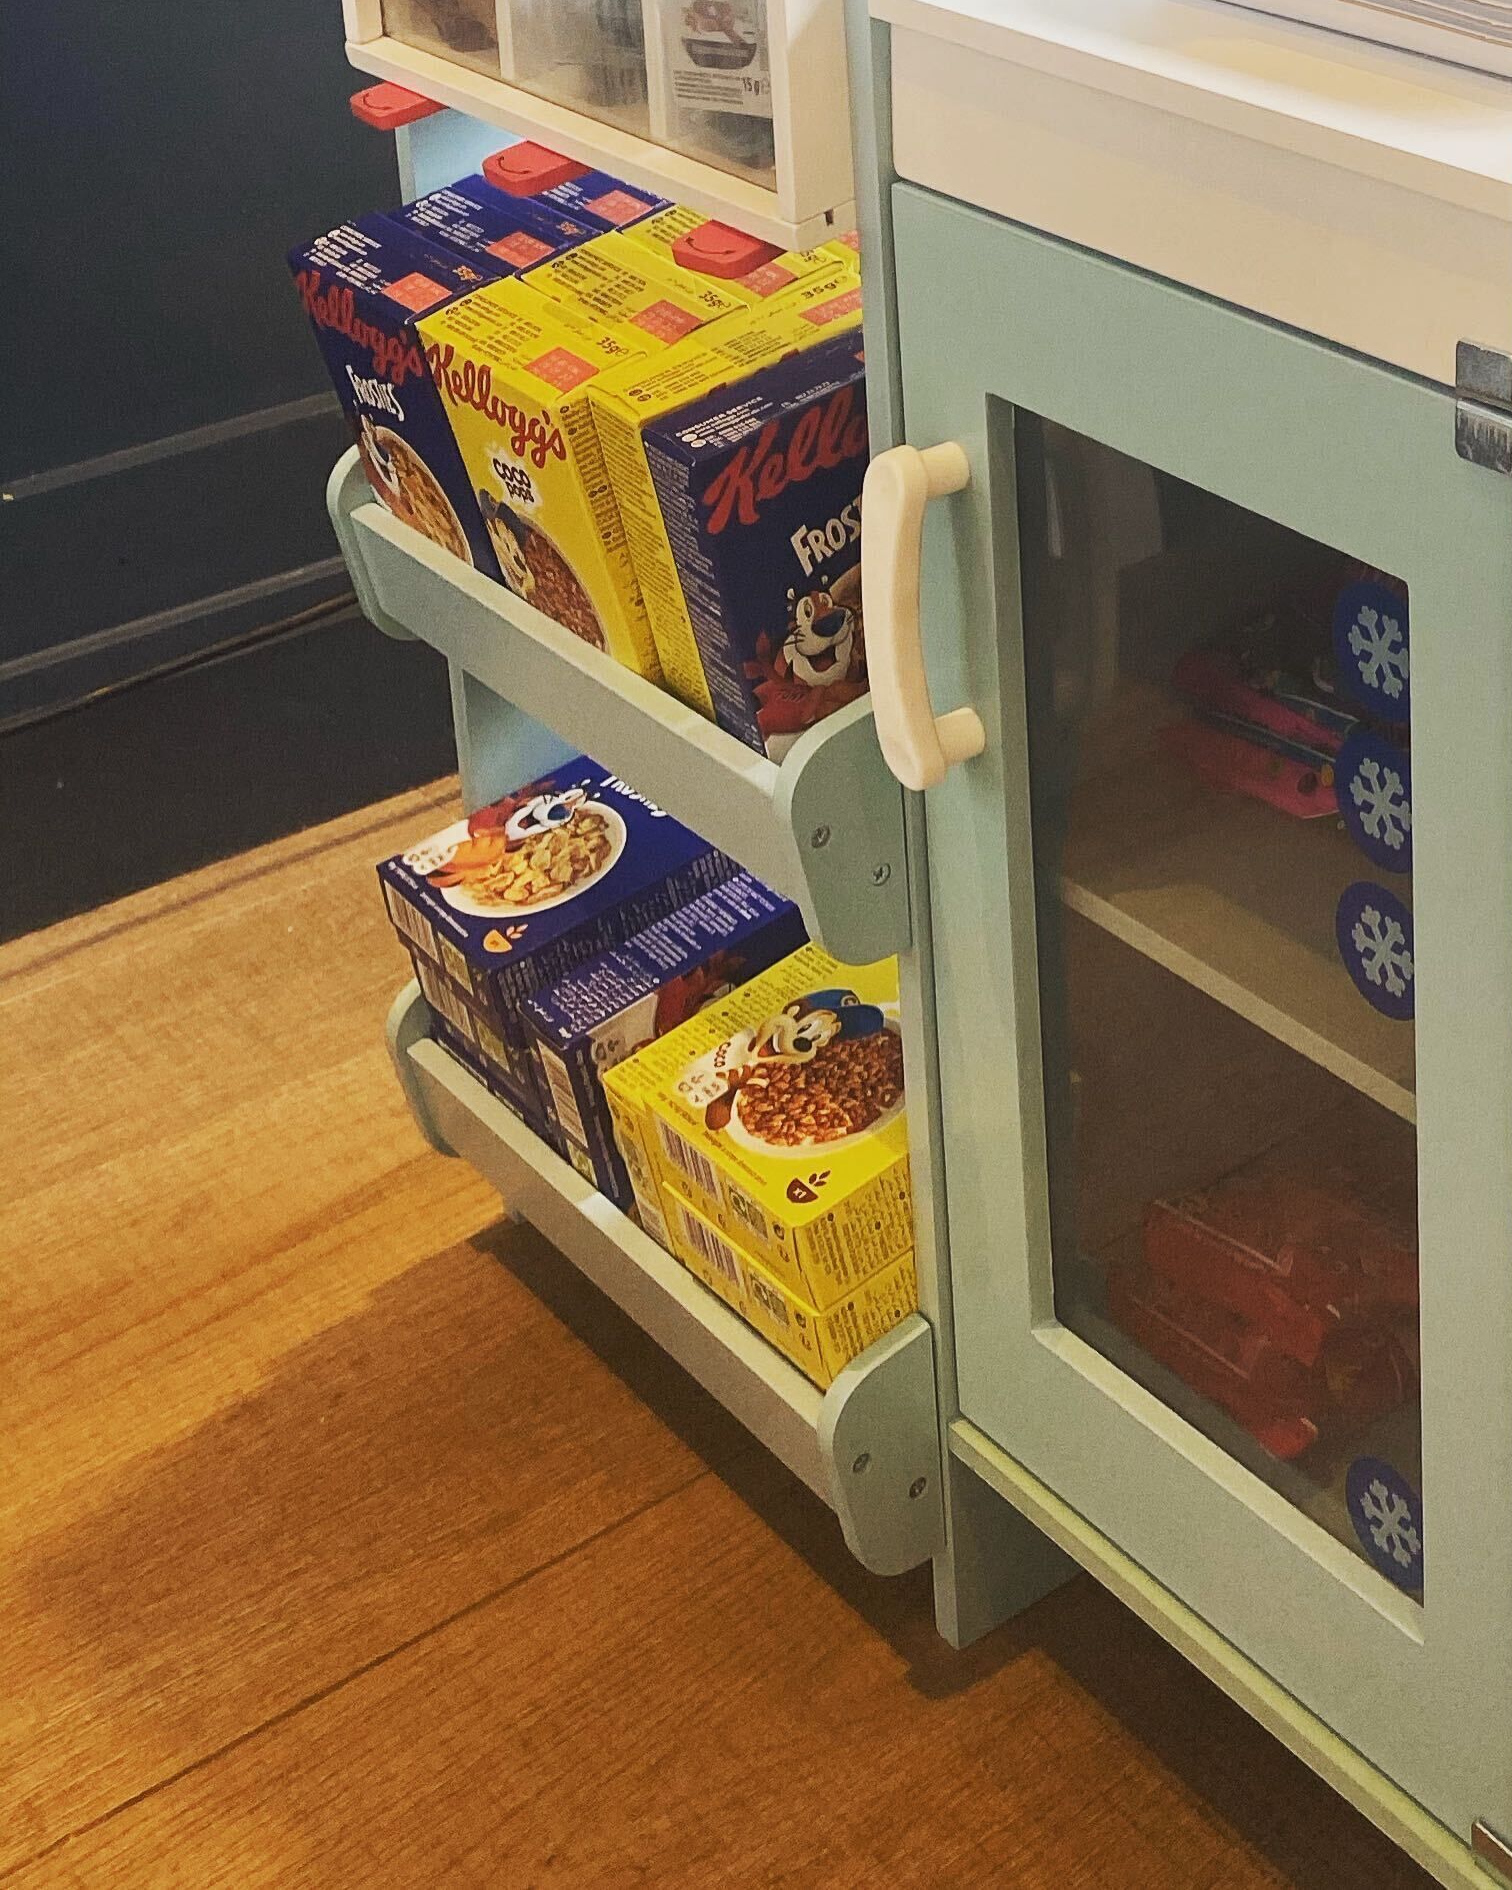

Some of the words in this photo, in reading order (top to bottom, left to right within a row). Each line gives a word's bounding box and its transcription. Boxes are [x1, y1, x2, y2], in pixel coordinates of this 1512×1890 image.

[295, 270, 424, 387] Kellogg's
[426, 343, 567, 470] Kellogg's
[505, 479, 536, 505] pops
